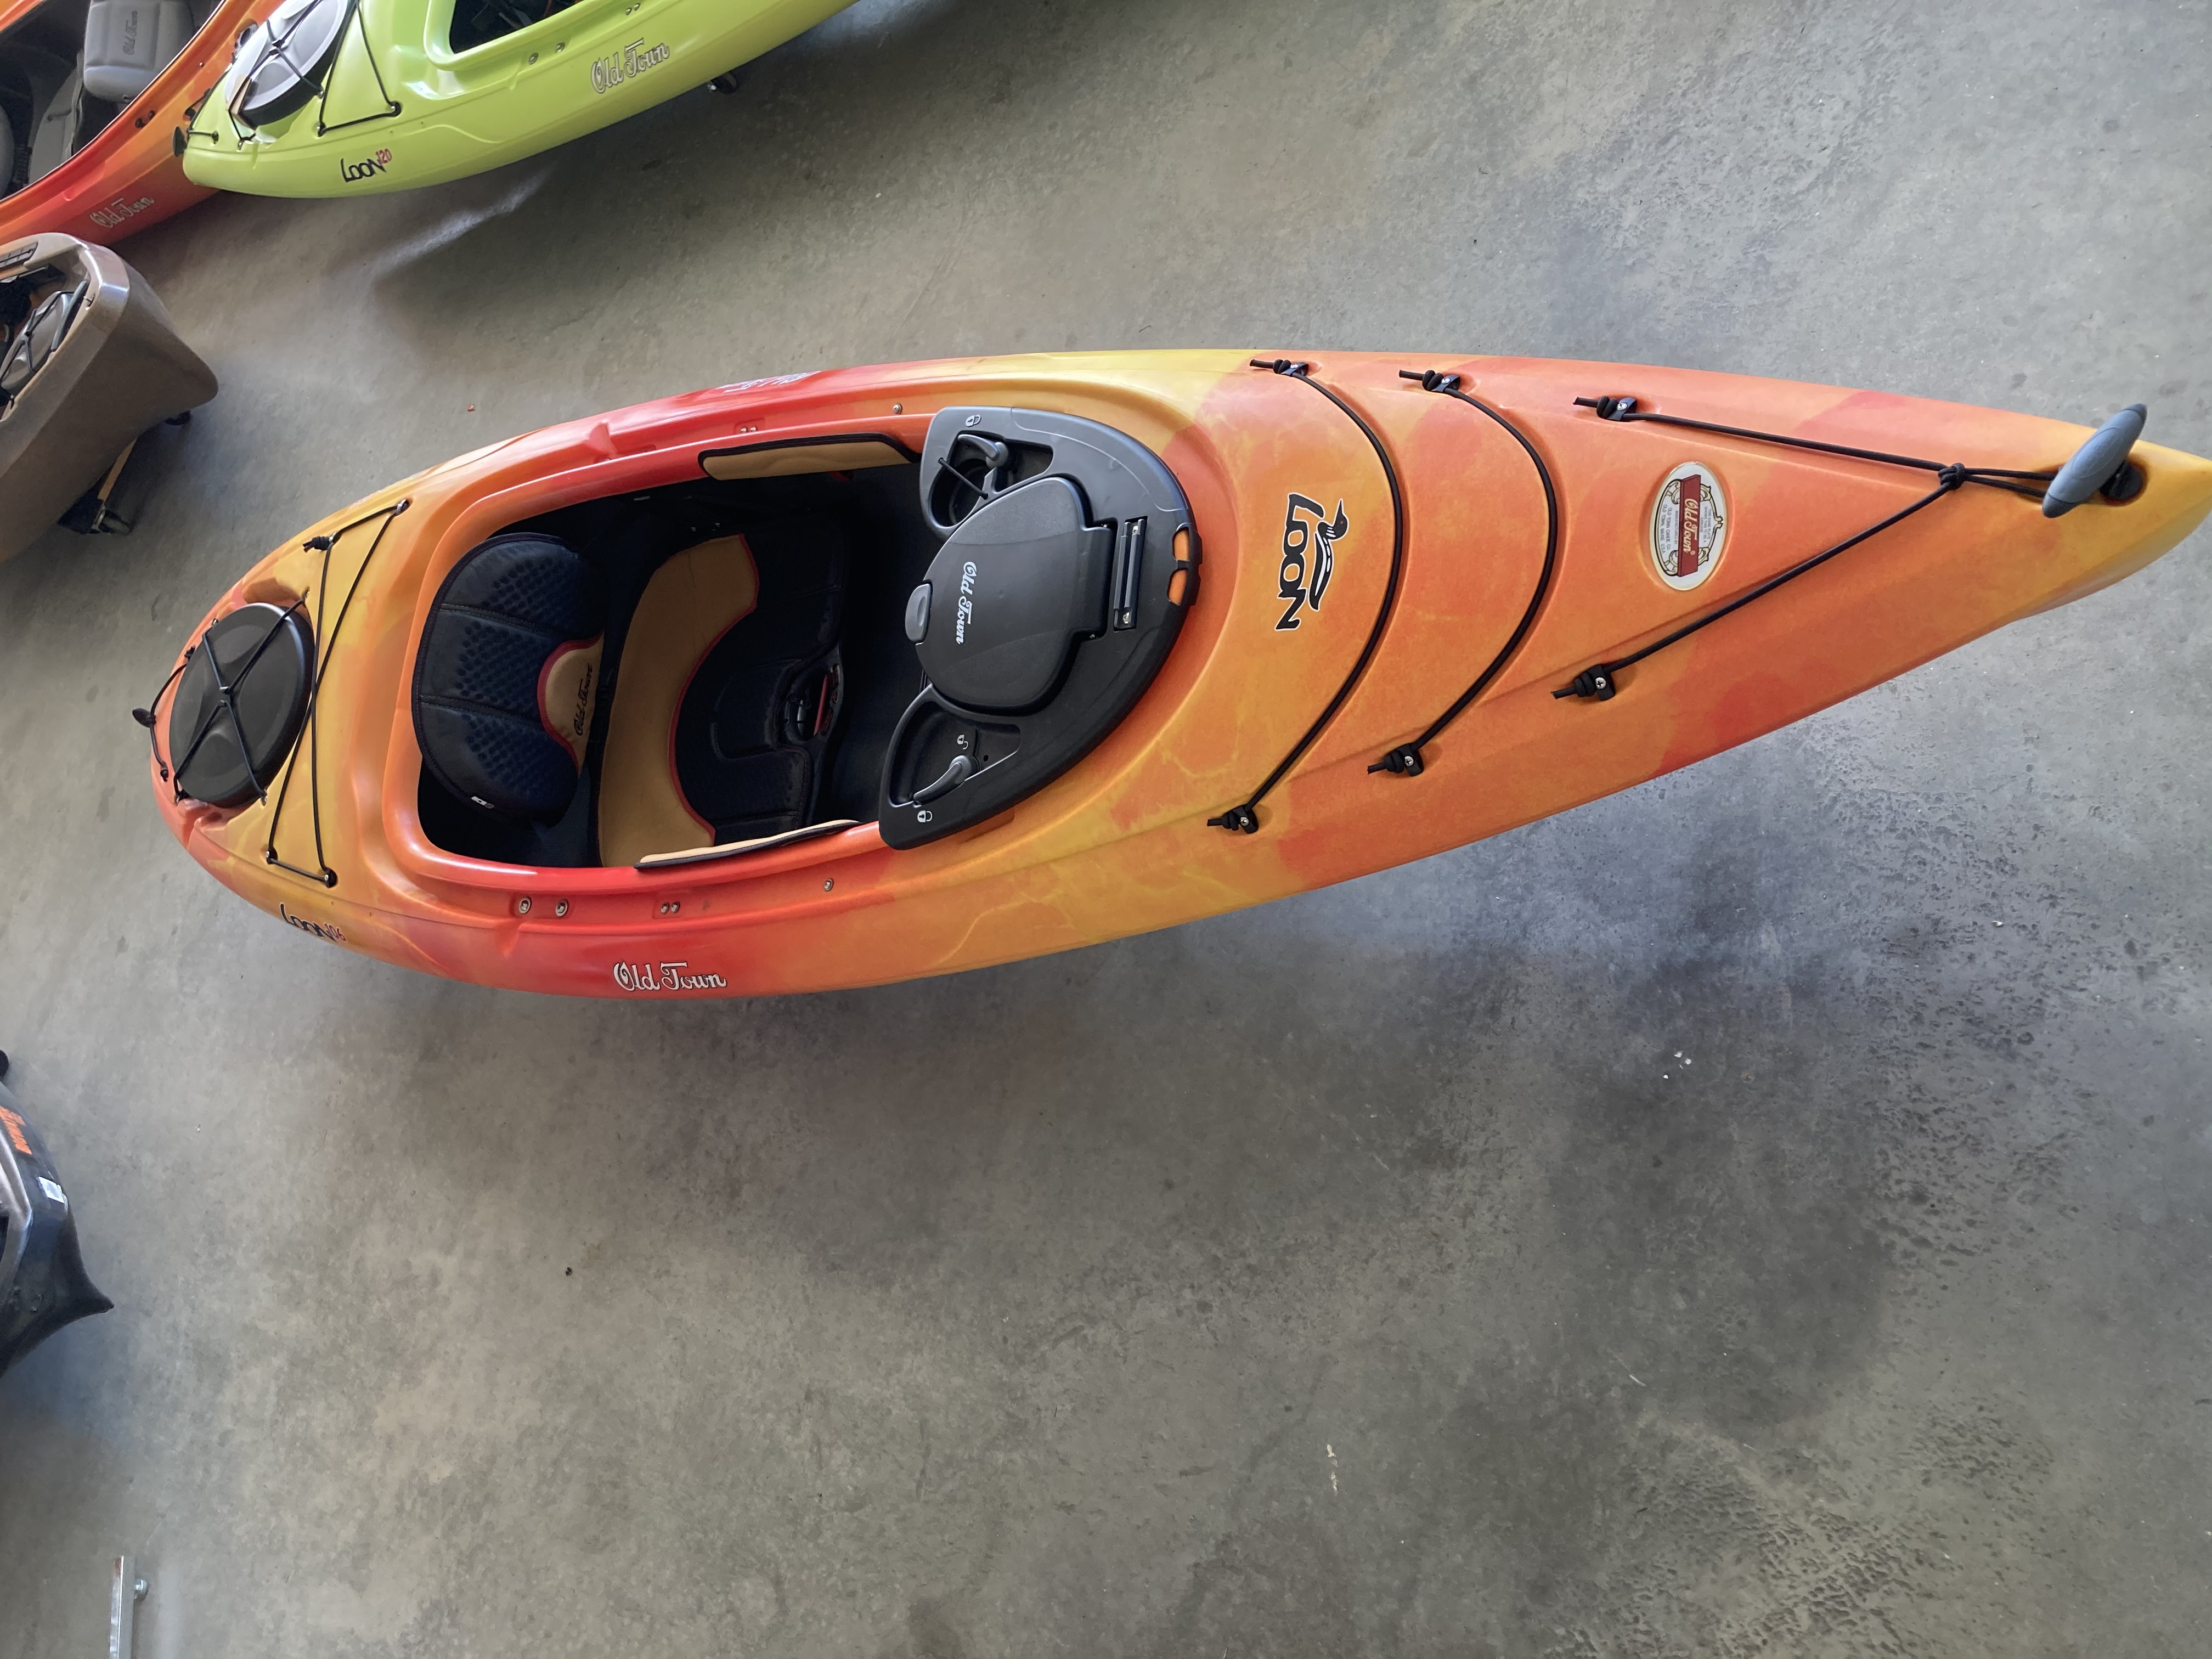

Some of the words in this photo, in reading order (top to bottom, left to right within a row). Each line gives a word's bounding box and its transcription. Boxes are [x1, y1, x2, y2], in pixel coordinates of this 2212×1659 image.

[591, 57, 624, 94] Old
[624, 37, 669, 77] Town
[340, 158, 387, 183] LOON
[375, 148, 392, 164] 120
[89, 207, 125, 228] Old
[111, 198, 155, 217] Town
[1684, 498, 1699, 522] Old
[961, 561, 977, 595] Old
[1274, 493, 1325, 631] LOON
[956, 596, 973, 645] Town
[578, 662, 593, 707] Town
[573, 703, 585, 736] Old
[279, 902, 339, 944] LOON
[613, 961, 661, 991] Old
[660, 961, 727, 990] Town
